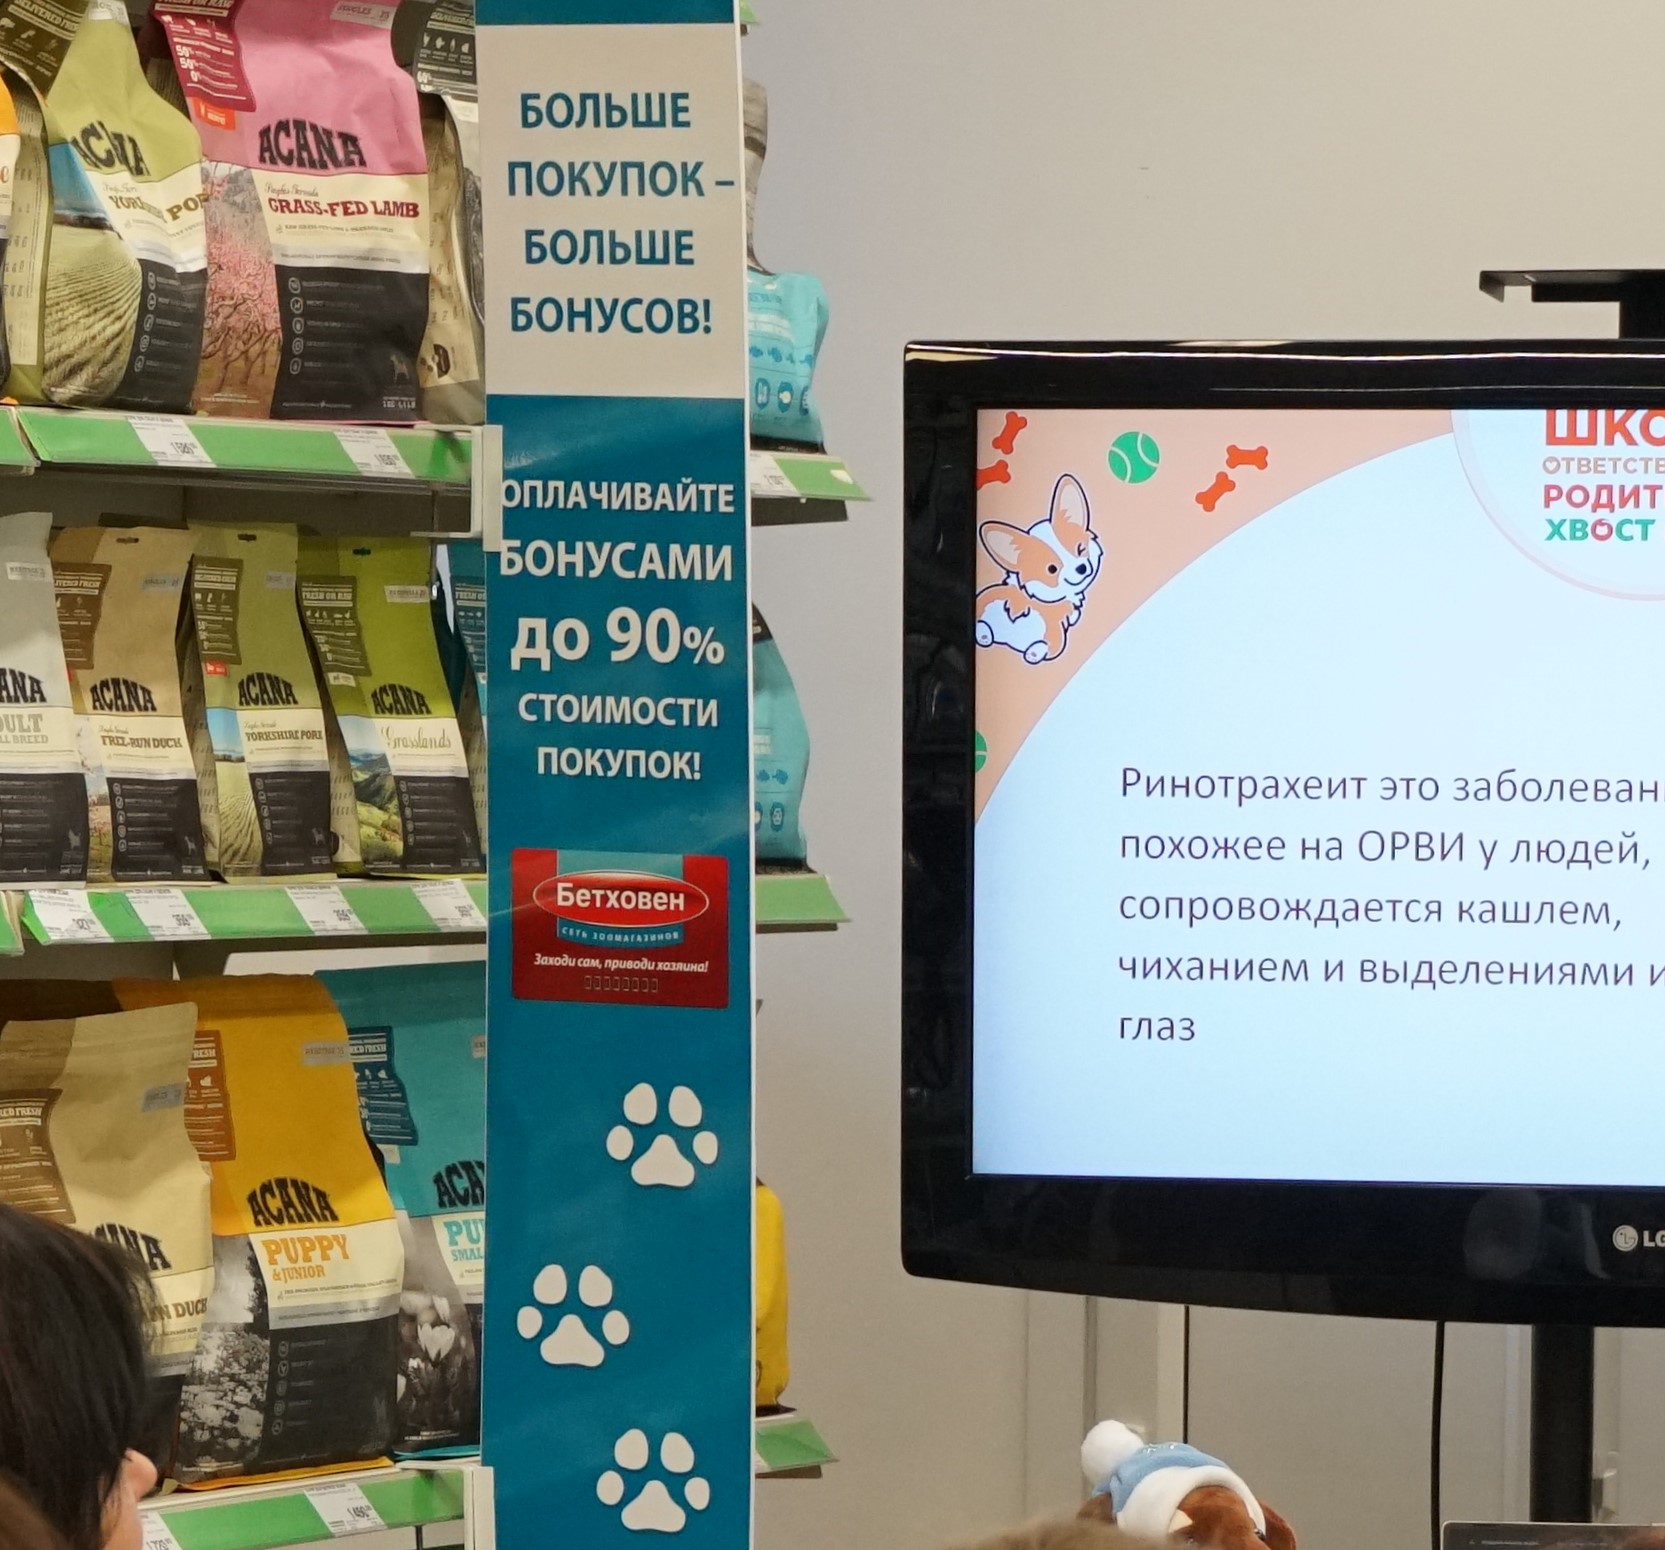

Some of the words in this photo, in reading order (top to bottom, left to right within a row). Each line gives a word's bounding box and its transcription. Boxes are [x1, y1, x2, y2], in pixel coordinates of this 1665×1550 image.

[520, 92, 691, 128] БОЛЬШЕ
[259, 118, 367, 171] ACANA
[507, 161, 705, 197] ПОКУПОК
[268, 197, 369, 218] GRASS-FED
[373, 200, 419, 219] LAMB
[524, 229, 695, 266] БОЛЬШЕ
[510, 297, 712, 334] БОНУСОВ!
[501, 477, 734, 513] ОПЛАЧИВАЙТЕ
[1544, 518, 1656, 543] ХВОСТ
[499, 539, 733, 581] БОНУСАМИ
[510, 616, 590, 672] до
[605, 605, 726, 666] 90%
[90, 677, 158, 713] ACANA
[238, 671, 299, 707] ACANA
[370, 683, 432, 716] ACANA
[518, 692, 719, 728] СТОИМОСТИ
[20, 734, 49, 744] BREED
[153, 737, 183, 749] DUCK
[381, 725, 452, 750] Grasslands
[537, 746, 702, 781] ПОКУПОК!
[1121, 767, 1368, 808] Ринотрахеит
[1379, 776, 1441, 802] это
[1120, 834, 1287, 861] похожее
[1300, 836, 1344, 861] на
[1358, 830, 1465, 862] ОРВИ
[1478, 838, 1499, 871] у
[1509, 830, 1651, 871] людей,
[555, 882, 685, 913] Бетховен
[1119, 895, 1443, 929] сопровождается
[1457, 899, 1623, 932] кашлем,
[592, 930, 680, 943] ЗООМАГАЗИНОВ
[533, 953, 575, 971] Заходи
[576, 958, 602, 973] сам,
[604, 957, 656, 976] приводи
[656, 959, 709, 975] хозяина!
[1118, 956, 1310, 982] чиханием
[1323, 959, 1345, 983] и
[1359, 958, 1634, 990] выделениями
[1119, 1016, 1197, 1042] глаз
[244, 1176, 341, 1228] ACANA
[262, 1232, 351, 1266] PUPPY
[282, 1263, 327, 1281] JUNIOR
